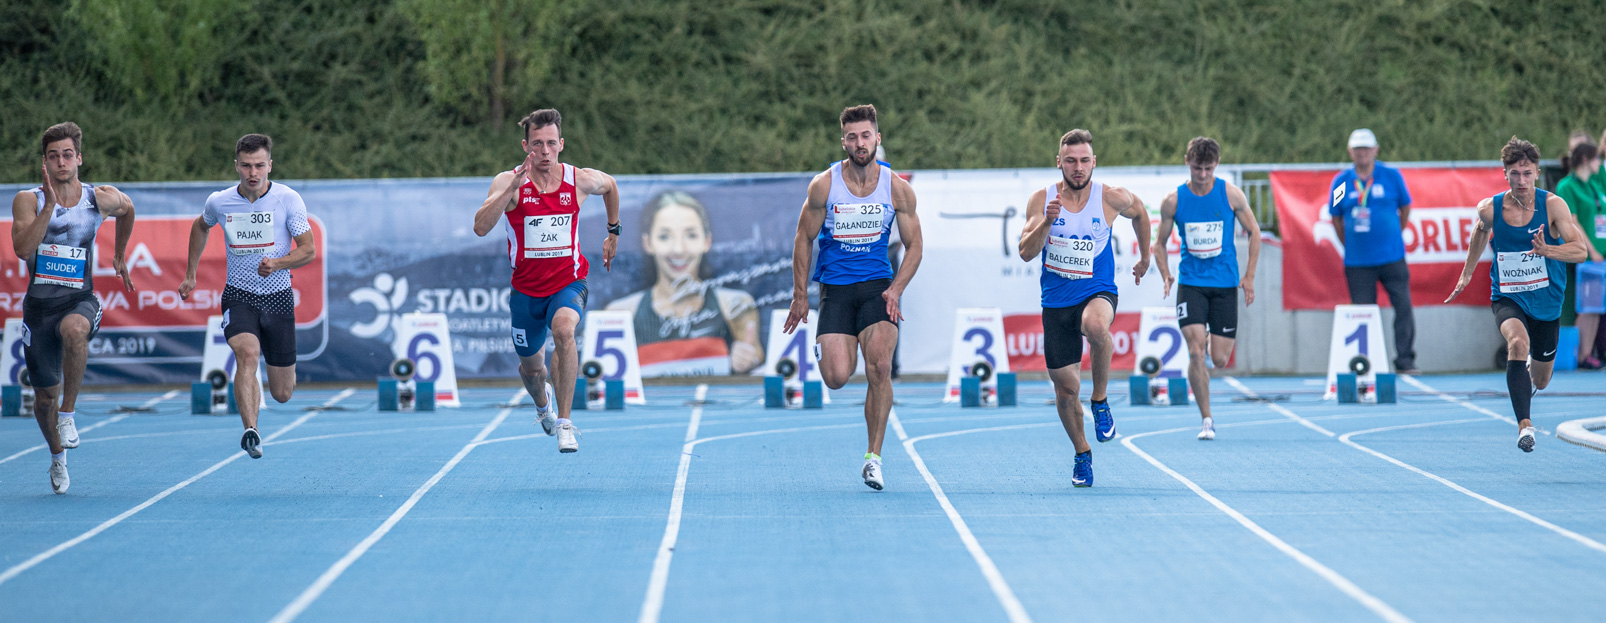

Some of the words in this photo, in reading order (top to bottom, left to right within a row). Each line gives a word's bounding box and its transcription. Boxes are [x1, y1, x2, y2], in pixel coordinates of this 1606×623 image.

[860, 204, 882, 215] 325
[250, 213, 271, 224] 303
[550, 215, 571, 227] 207
[835, 220, 883, 230] GAŁANDZIEJ
[1206, 223, 1223, 233] 275
[236, 230, 263, 240] PAJĄK
[541, 233, 558, 243] ŻAK
[1404, 217, 1479, 254] ORLE
[1072, 240, 1094, 252] 320
[1193, 237, 1218, 246] BURDA
[69, 248, 83, 259] 17
[840, 243, 871, 253] POZNAŃ
[1049, 252, 1091, 266] BALCEREK
[45, 261, 77, 274] SIUDEK
[1503, 265, 1543, 278] WOŹNIAK
[1526, 283, 1540, 291] 2019
[118, 336, 157, 354] 2019
[516, 333, 526, 345] 5
[1344, 322, 1369, 357] 1
[406, 332, 442, 382] 6
[593, 330, 627, 381] 5
[778, 329, 815, 382] 4
[961, 326, 997, 377] 3
[1147, 326, 1183, 379] 2
